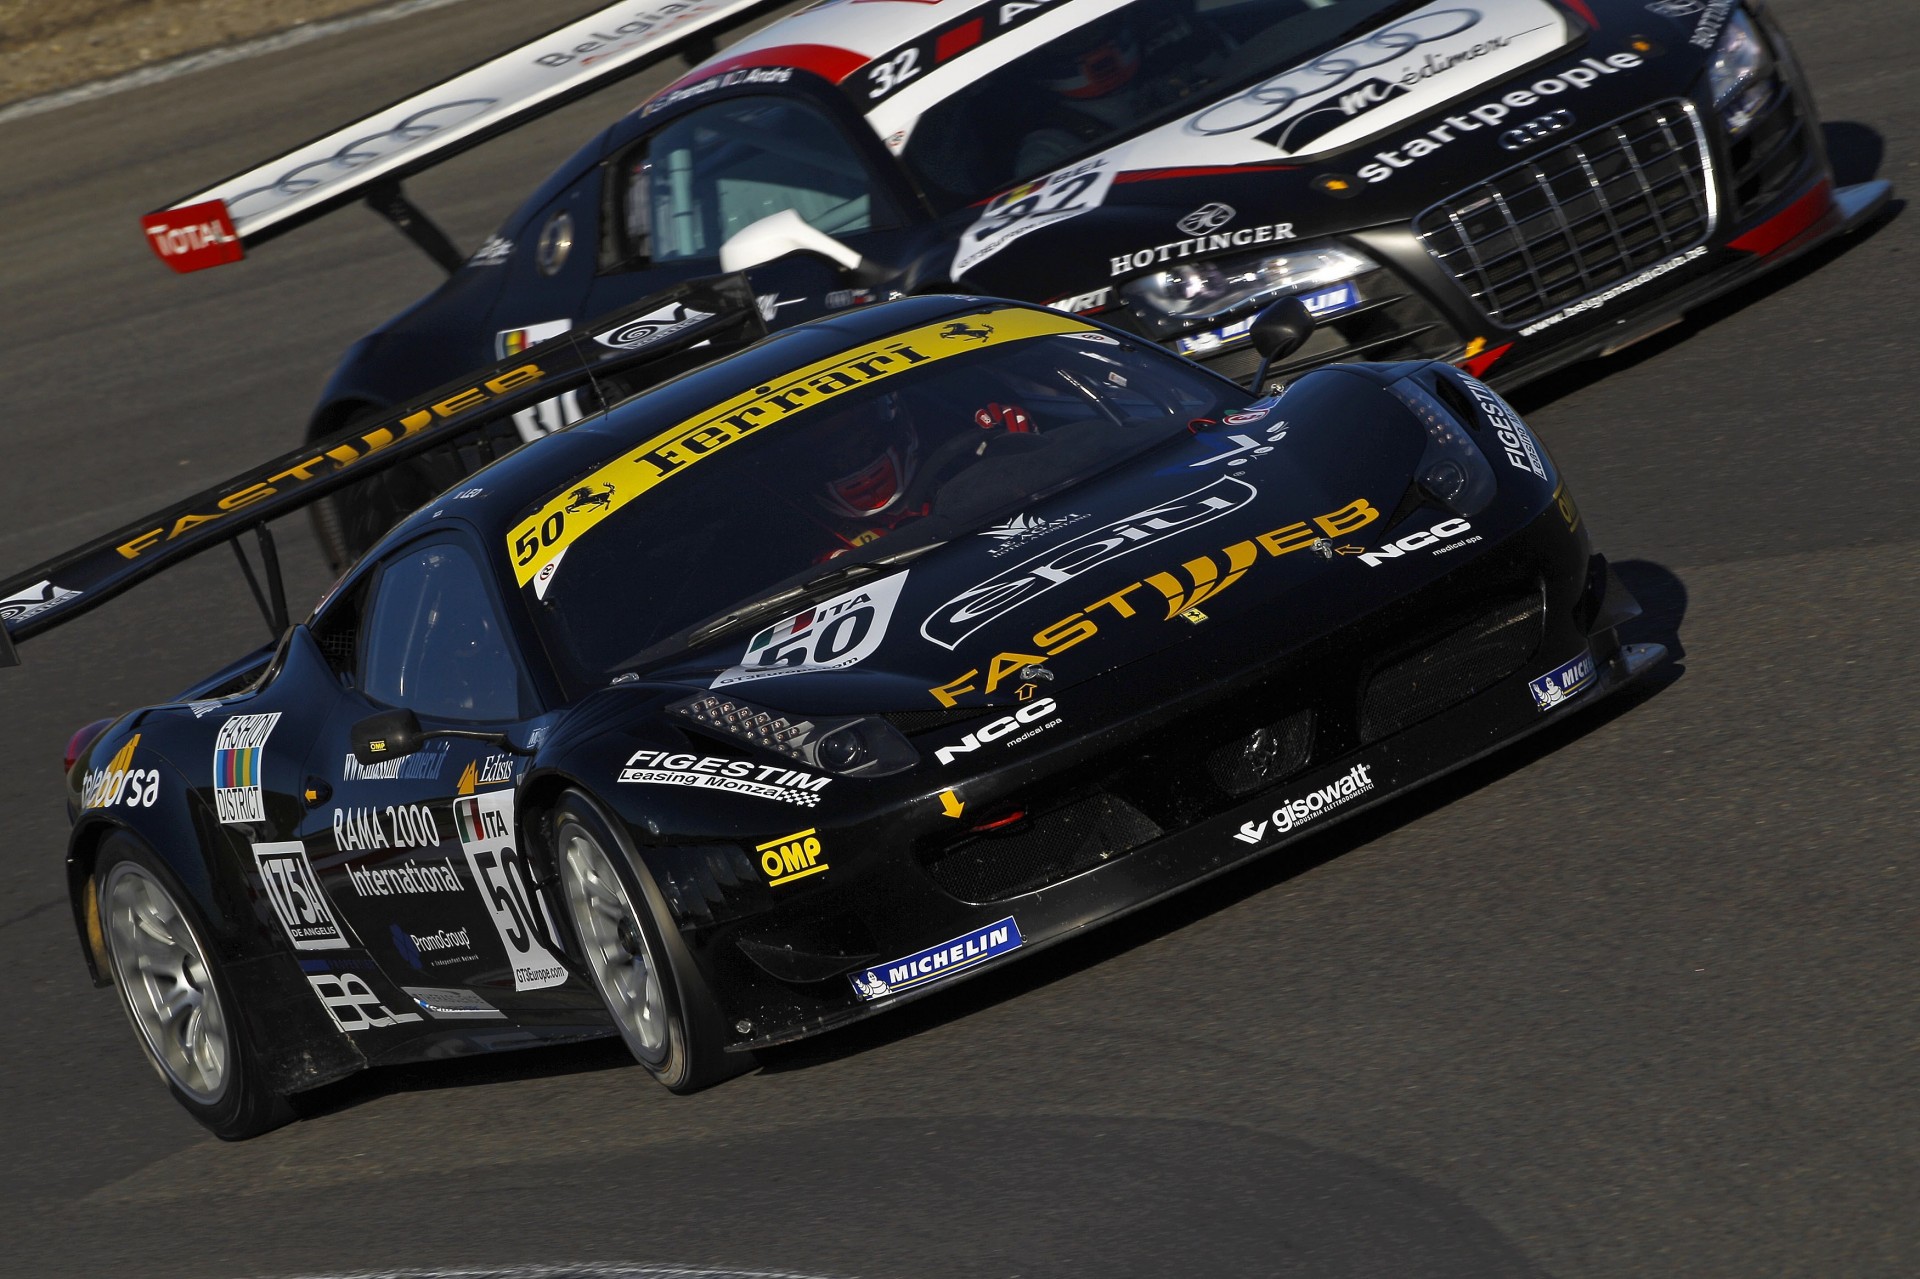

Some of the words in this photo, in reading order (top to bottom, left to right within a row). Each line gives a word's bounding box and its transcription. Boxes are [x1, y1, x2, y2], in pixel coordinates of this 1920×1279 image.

[534, 0, 702, 67] Belgia
[867, 47, 922, 99] 32
[1357, 52, 1644, 184] startpeople
[974, 172, 1104, 242] 32
[146, 219, 237, 256] TOTAL
[1109, 222, 1297, 276] HOTTINGER
[633, 341, 932, 479] Ferrari
[514, 510, 565, 567] 50
[1432, 539, 1466, 557] medical
[1466, 534, 1483, 546] spa
[817, 593, 872, 623] ITA
[928, 498, 1380, 708] FASTWEB
[744, 606, 876, 673] 50
[217, 713, 275, 750] FASHION
[370, 742, 387, 751] OMP
[1006, 725, 1044, 749] medical
[1045, 717, 1063, 730] spa
[81, 765, 160, 809] teleborsa
[480, 753, 514, 783] Edisis
[619, 769, 699, 786] Leasing
[704, 776, 778, 798] Monza
[625, 750, 832, 792] FIGESTIM
[217, 786, 260, 821] DISTRICT
[1272, 763, 1371, 833] gisowatt
[333, 806, 390, 852] RAMA
[386, 804, 440, 848] 2000
[482, 810, 509, 840] ITA
[1293, 809, 1323, 828] INDUSTRIA
[761, 837, 821, 877] OMP
[344, 858, 465, 897] International
[291, 929, 304, 938] DE
[304, 926, 336, 936] ANGELIS
[410, 928, 470, 951] PromoGroup
[516, 966, 565, 983] GT3Europe.com
[888, 926, 1008, 984] MICHELIN
